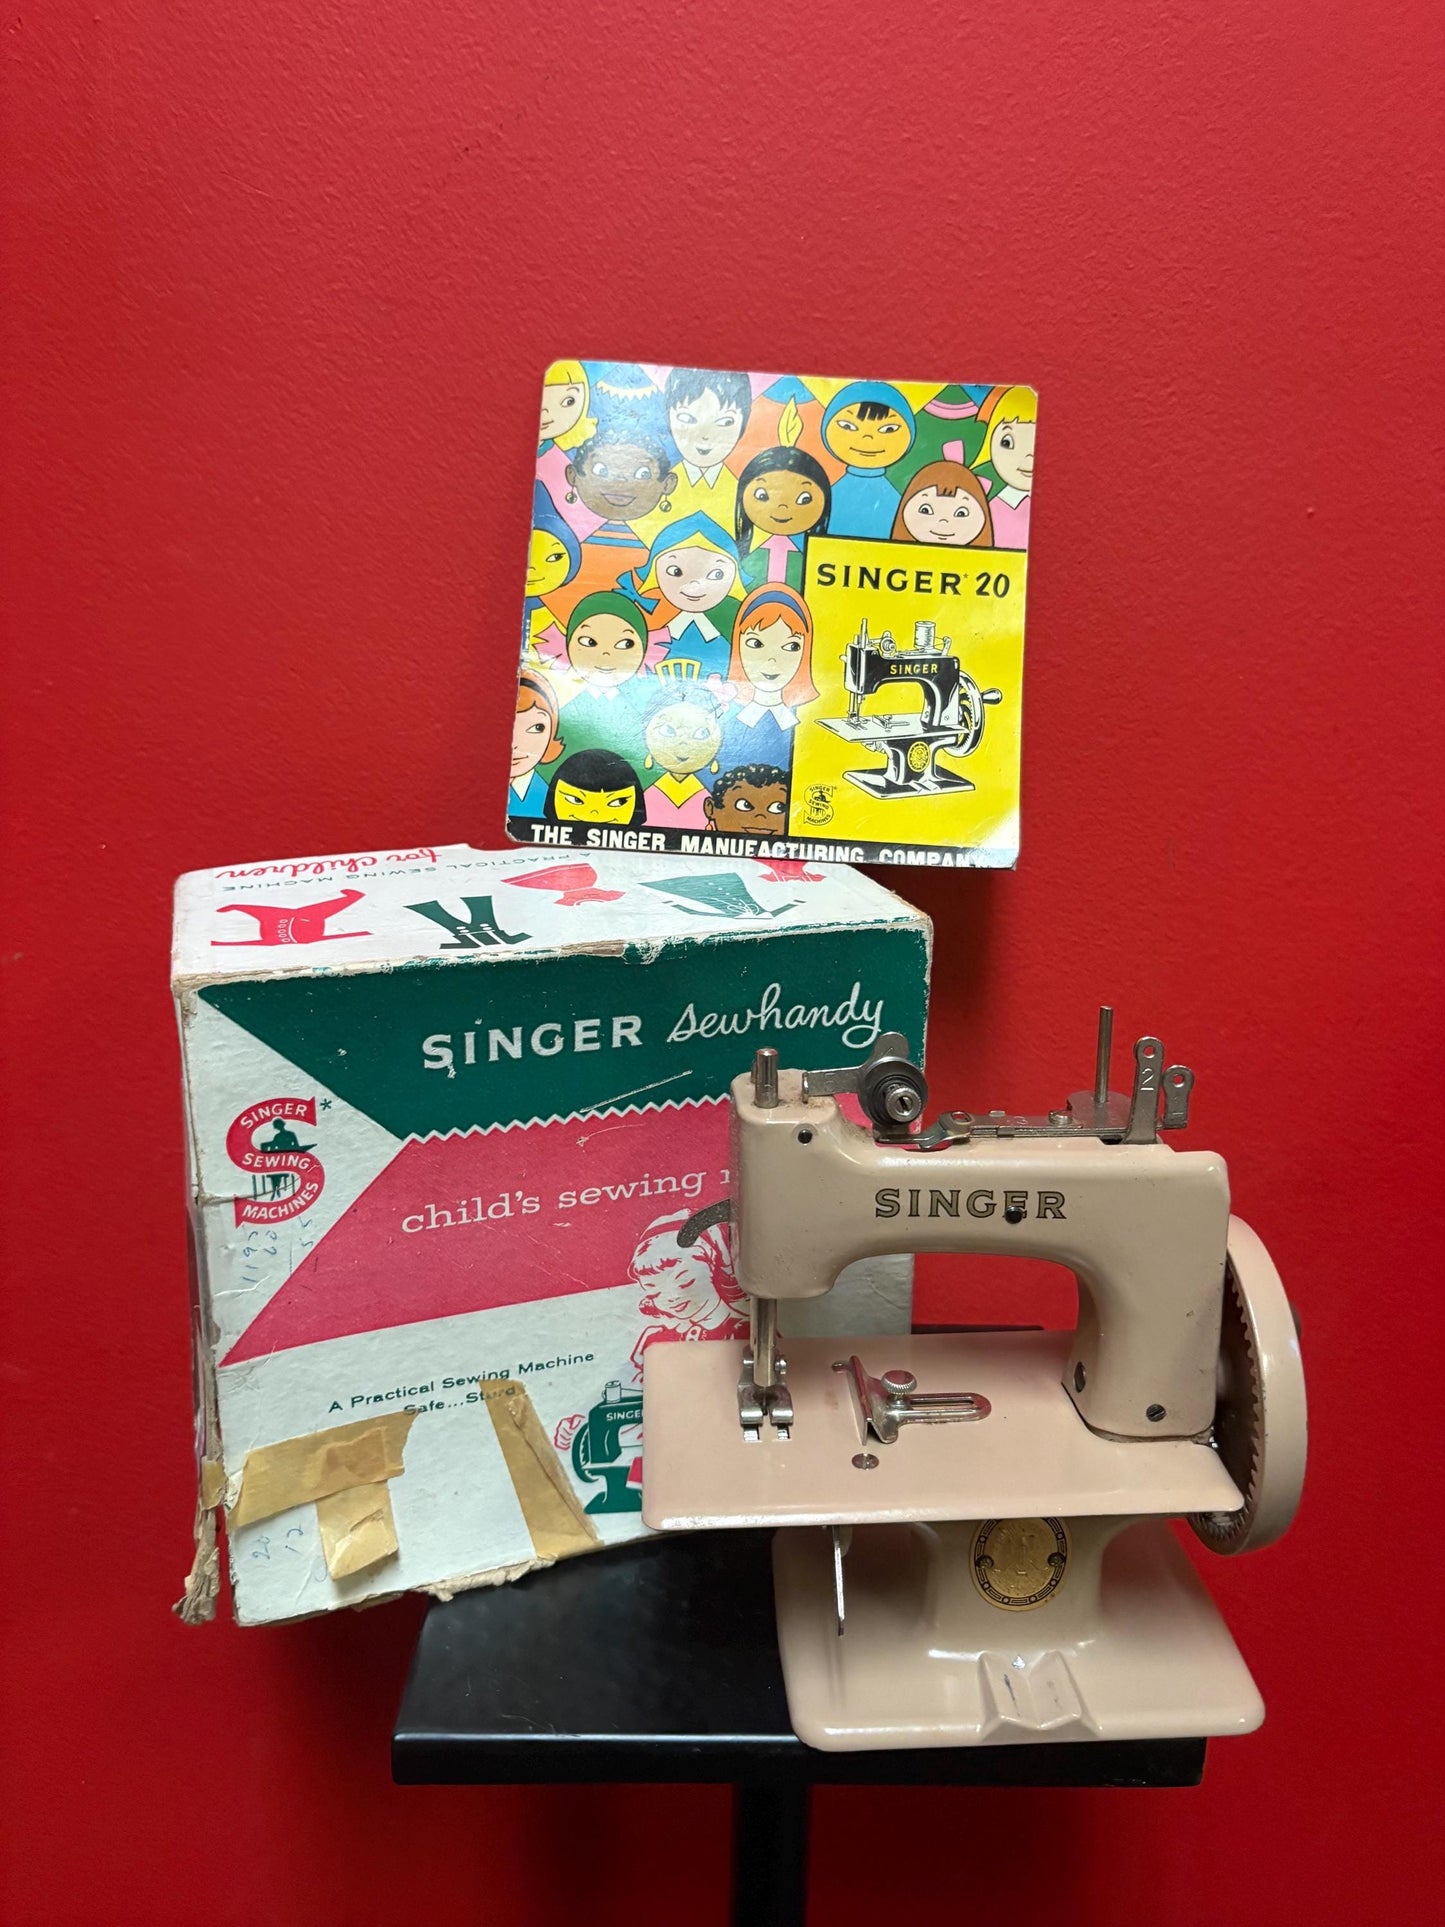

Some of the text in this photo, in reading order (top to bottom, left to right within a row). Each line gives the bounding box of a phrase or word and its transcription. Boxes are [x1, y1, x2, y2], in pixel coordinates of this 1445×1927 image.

[817, 563, 1010, 599] SINGER 20
[889, 663, 939, 675] SINGER
[809, 785, 831, 793] SINGER
[531, 823, 573, 846] THE
[586, 828, 666, 852] SINGER
[681, 835, 865, 864] MANUFACTURING
[215, 848, 443, 879] for children
[346, 867, 437, 880] SEWING
[446, 853, 570, 868] PRACTICAL
[223, 876, 334, 892] MACHINE
[422, 1015, 643, 1070] SINGER
[1141, 1067, 1155, 1091] 2
[240, 1103, 308, 1129] SINGER
[242, 1152, 311, 1170] SEWING
[242, 1182, 319, 1220] MACHINES
[402, 1171, 707, 1234] child's sewing
[875, 1188, 1066, 1220] SINGER
[328, 1351, 595, 1414] A Practical Sewing Machine
